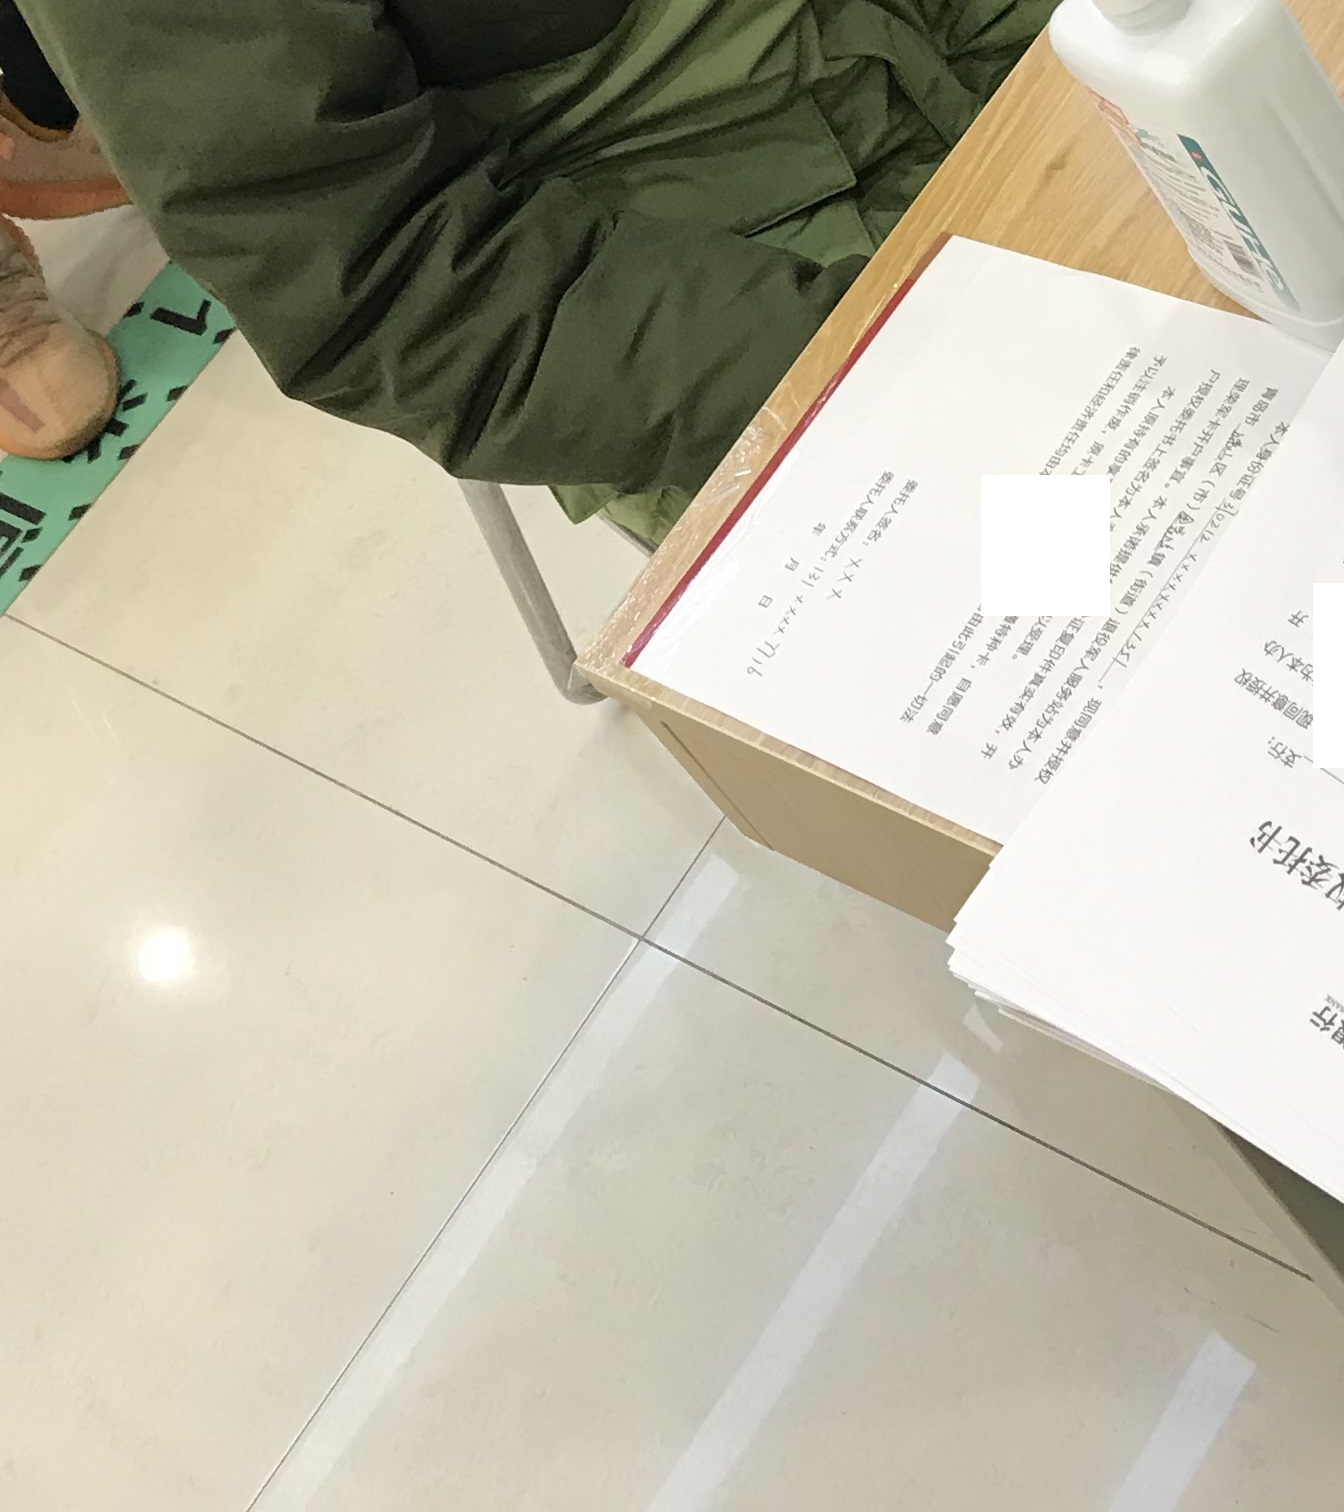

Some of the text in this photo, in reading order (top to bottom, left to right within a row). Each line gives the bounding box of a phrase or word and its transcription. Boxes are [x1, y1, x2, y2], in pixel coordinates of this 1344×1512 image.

[1099, 382, 1177, 486] 本人原持有的享
[1241, 383, 1279, 428] 青岛市
[1227, 418, 1290, 503] 本人身份证号
[756, 519, 827, 610] 年 月 日
[1260, 635, 1317, 684] 为本人办
[1286, 606, 1308, 629] 开
[897, 602, 989, 727] 由此引起的一切法
[977, 608, 1089, 762] 证复印件真实有效，开
